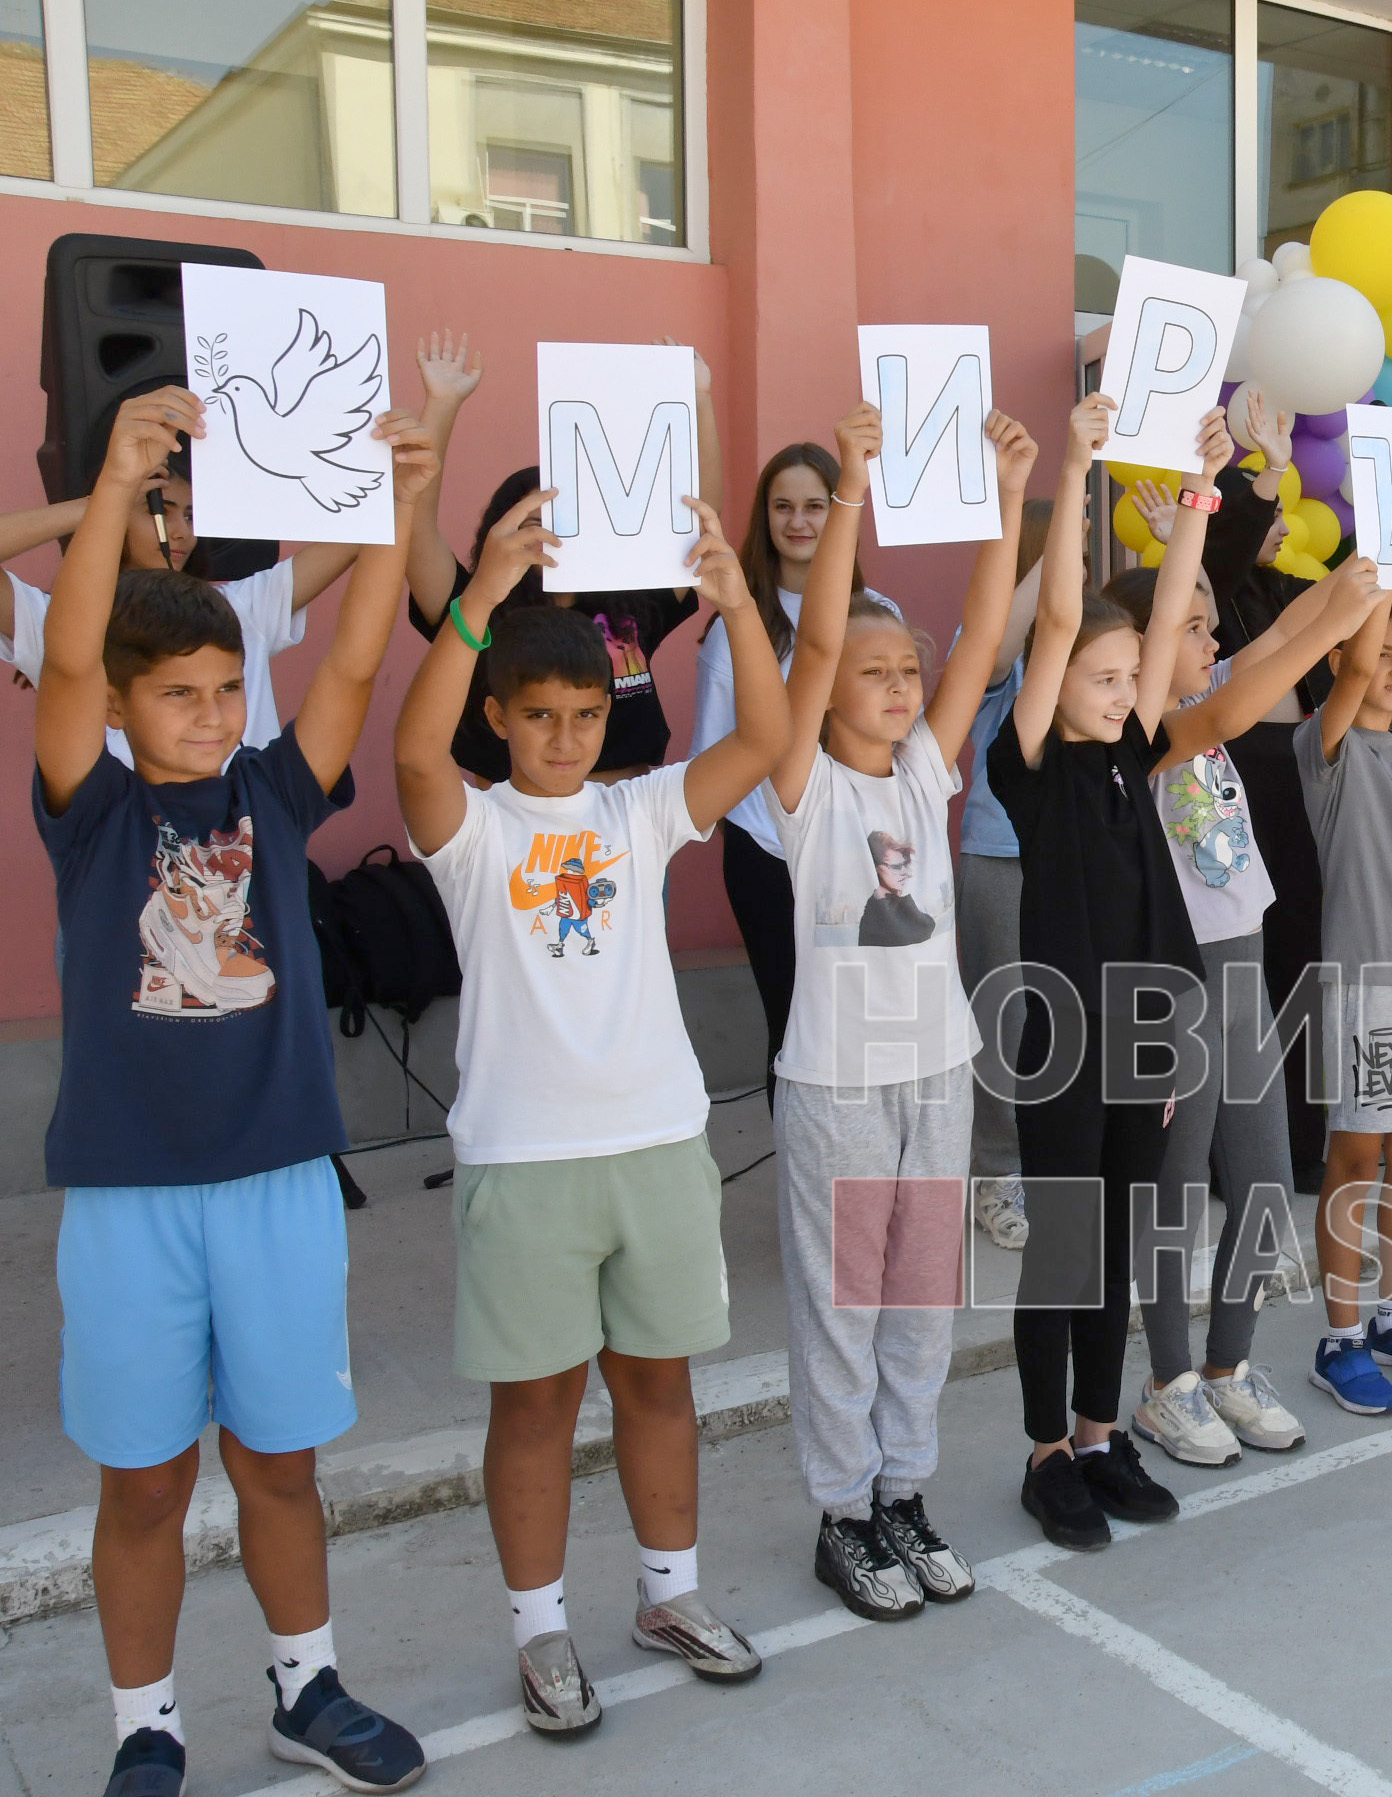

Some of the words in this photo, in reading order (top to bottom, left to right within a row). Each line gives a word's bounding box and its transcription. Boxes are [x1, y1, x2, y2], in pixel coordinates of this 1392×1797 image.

[876, 354, 987, 508] И
[525, 830, 602, 876] NIKE
[558, 891, 570, 915] NIKE
